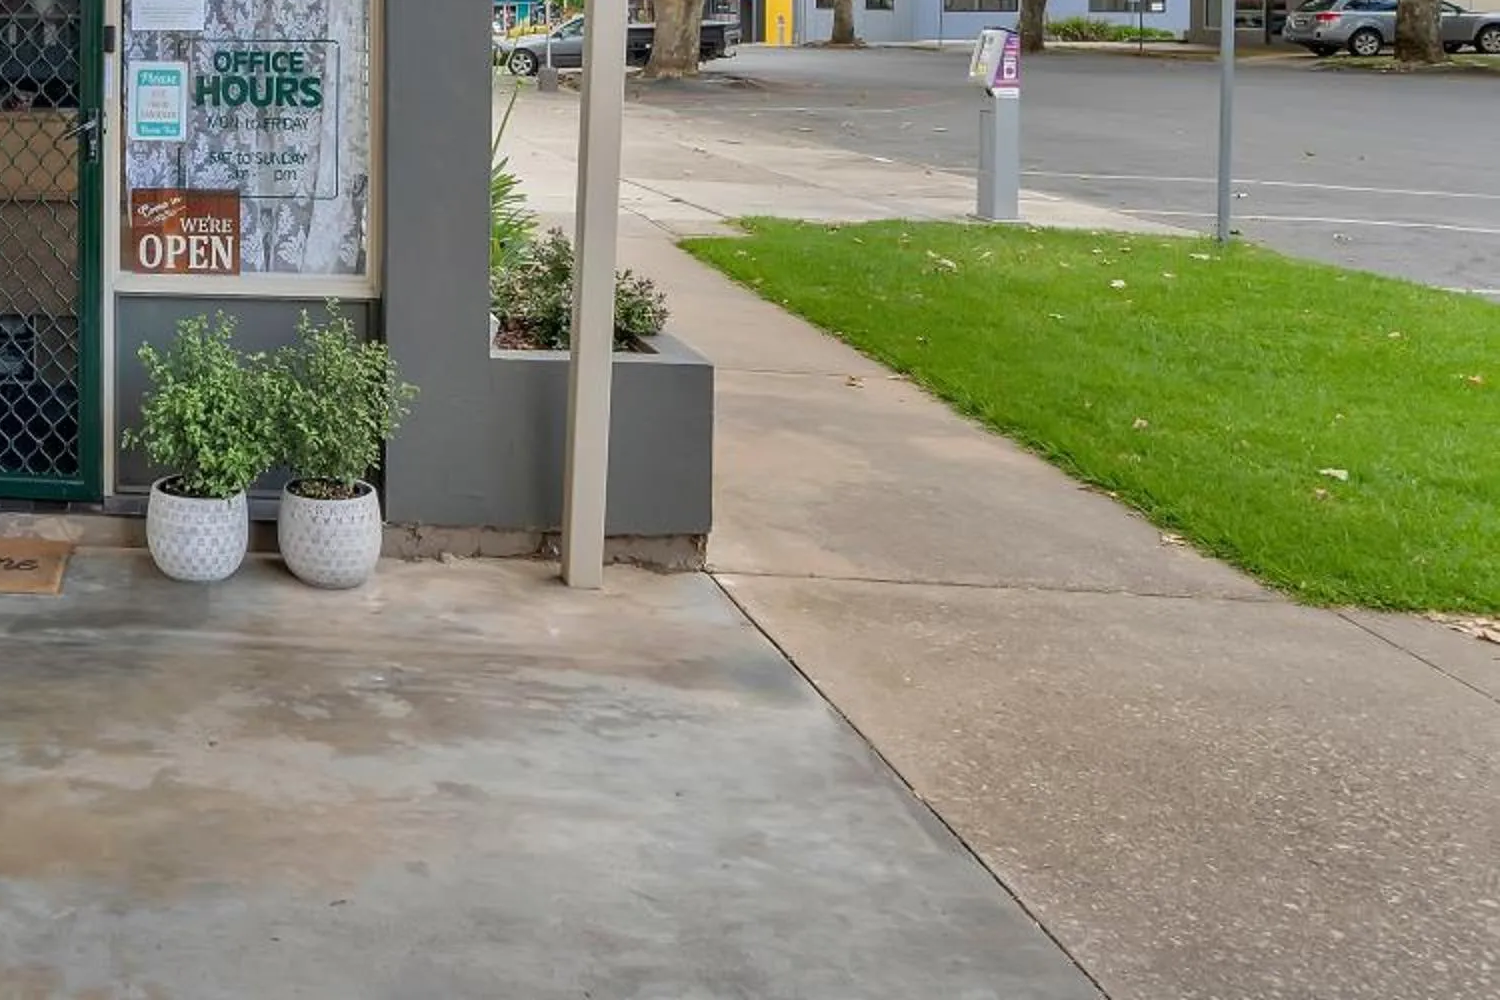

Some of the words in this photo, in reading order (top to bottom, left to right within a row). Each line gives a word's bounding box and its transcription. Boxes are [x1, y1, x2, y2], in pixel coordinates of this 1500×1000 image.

[214, 50, 305, 73] OFFICE
[195, 75, 324, 108] HOURS
[209, 151, 232, 165] SAT
[254, 151, 308, 166] SUNDAY
[180, 212, 233, 233] WE'RE
[139, 233, 234, 269] OPEN
